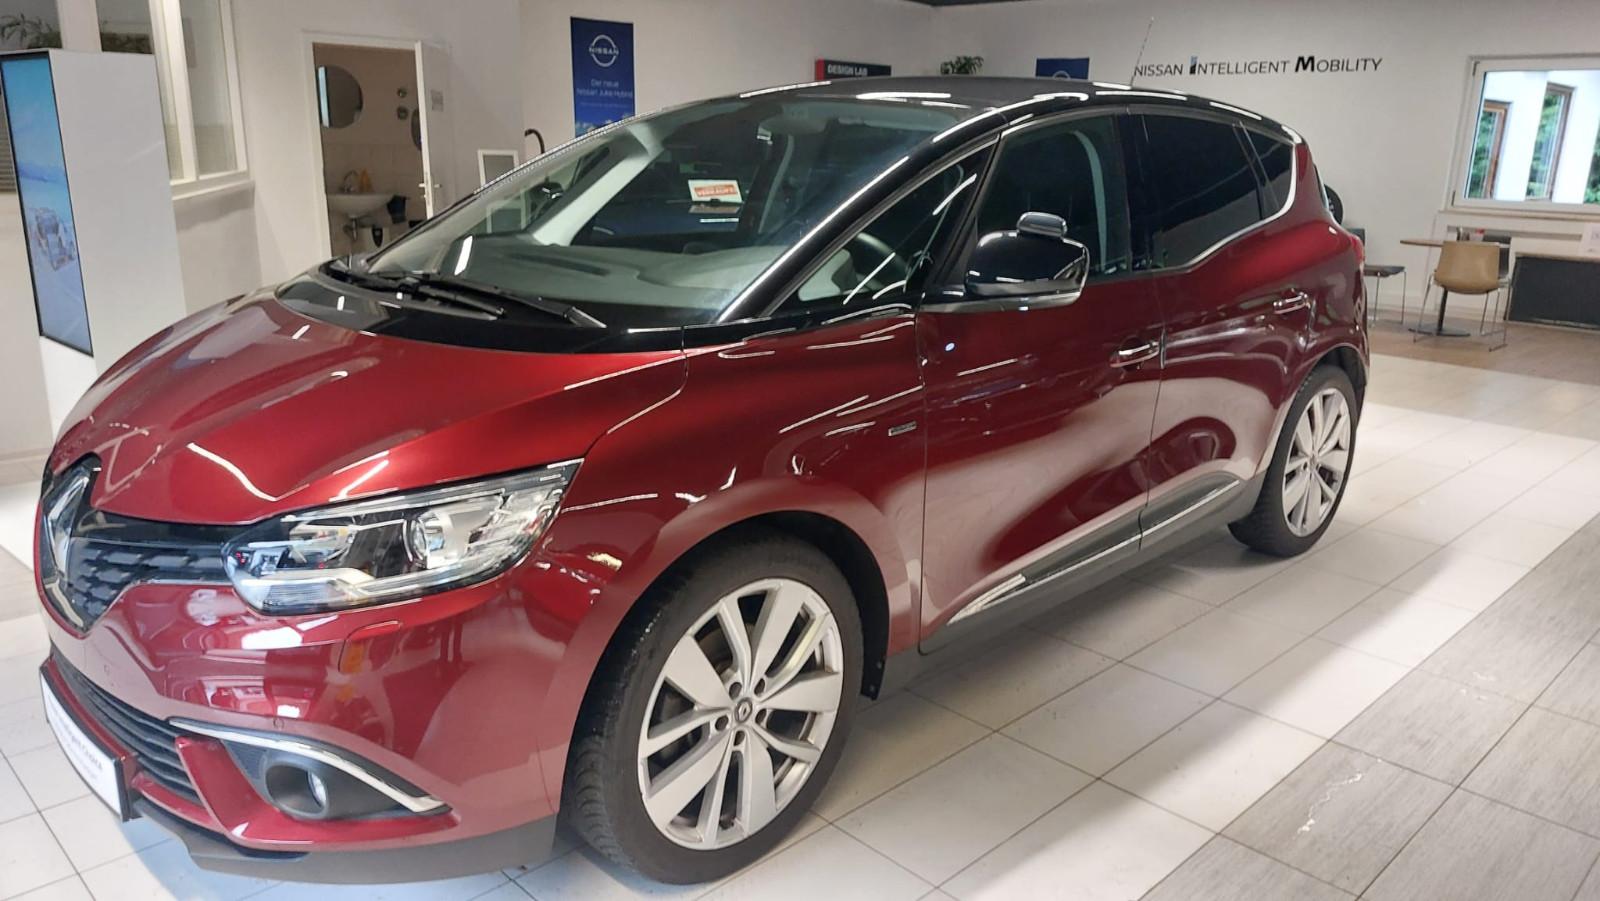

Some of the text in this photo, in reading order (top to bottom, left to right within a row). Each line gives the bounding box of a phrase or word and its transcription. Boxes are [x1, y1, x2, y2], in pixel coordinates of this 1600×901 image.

[588, 47, 619, 56] NISSAN
[827, 64, 868, 76] DESIGN LAB
[1133, 56, 1383, 76] NISSAN INTELLIGENT MOBILITY
